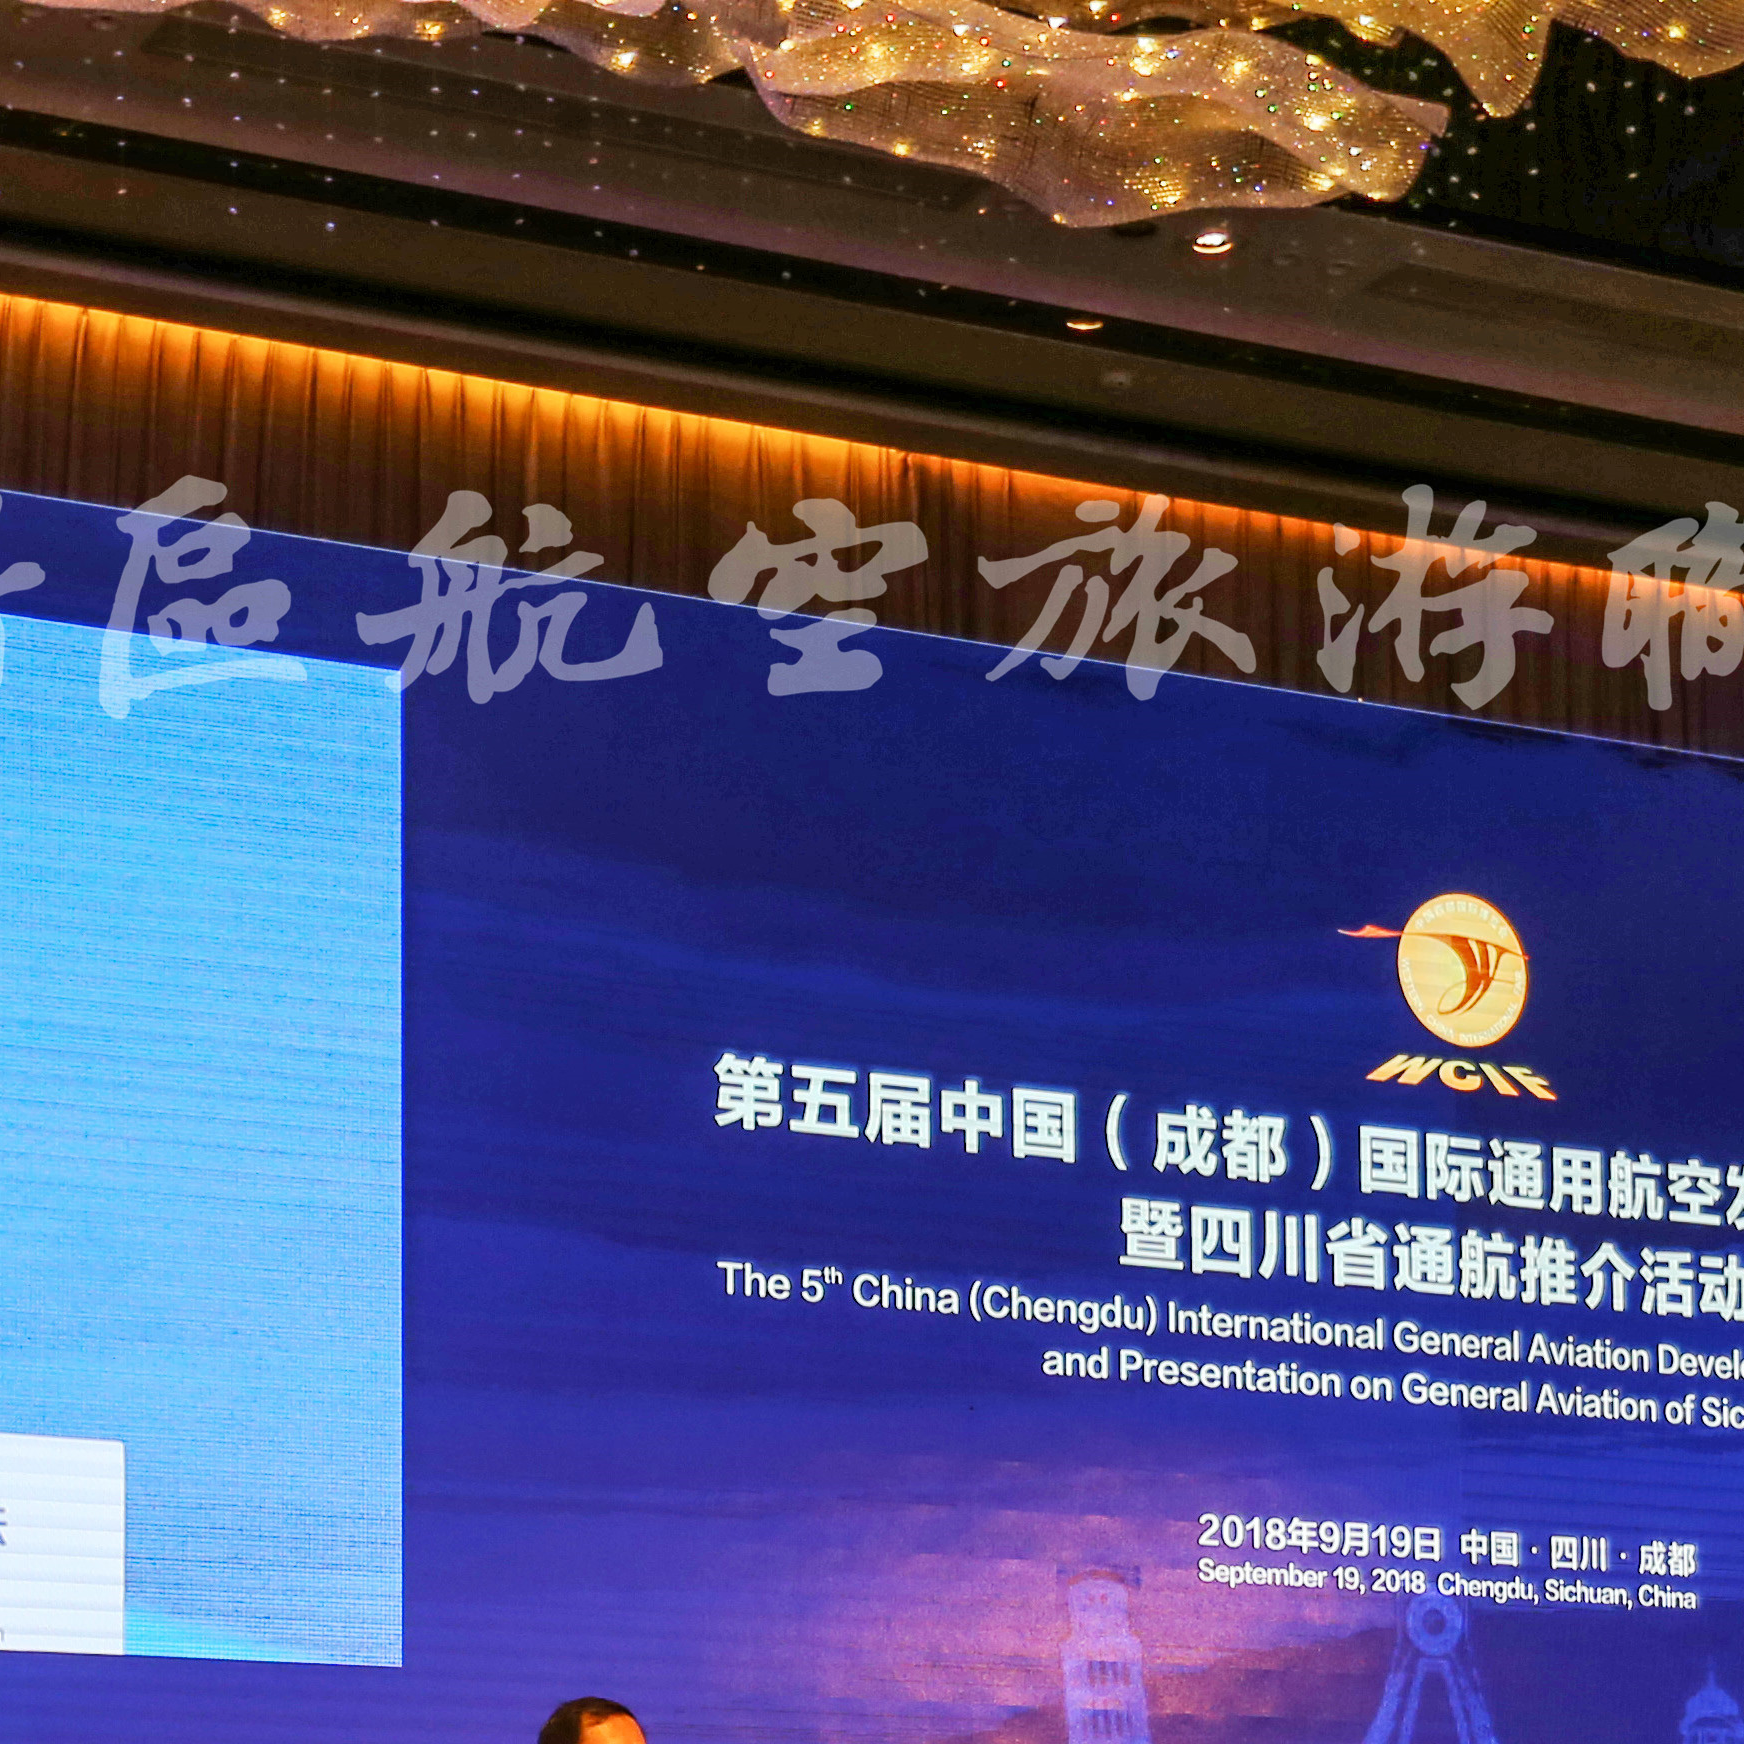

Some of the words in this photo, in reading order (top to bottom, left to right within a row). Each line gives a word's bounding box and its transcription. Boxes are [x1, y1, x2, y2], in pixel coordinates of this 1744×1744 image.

[1366, 1053, 1557, 1101] WCIF
[716, 1261, 792, 1300] The
[800, 1266, 843, 1303] 5th
[852, 1272, 960, 1316] China
[968, 1280, 1159, 1336] (Chengdu)
[1167, 1301, 1384, 1351] International
[1393, 1321, 1520, 1365] General
[1528, 1335, 1650, 1373] Aviation
[1042, 1347, 1109, 1381] and
[1119, 1348, 1342, 1398] Presentation
[1350, 1374, 1393, 1402] on
[1402, 1373, 1527, 1413] General
[1536, 1384, 1657, 1422] Aviation
[1665, 1392, 1694, 1426] of
[1198, 1513, 1442, 1562] 2018年9月19日
[1198, 1558, 1328, 1591] September
[1332, 1565, 1366, 1595] 19,
[1371, 1570, 1426, 1595] 2018
[1437, 1572, 1540, 1605] Chengdu,
[1545, 1578, 1634, 1611] Sichuan,
[1638, 1583, 1697, 1611] China
